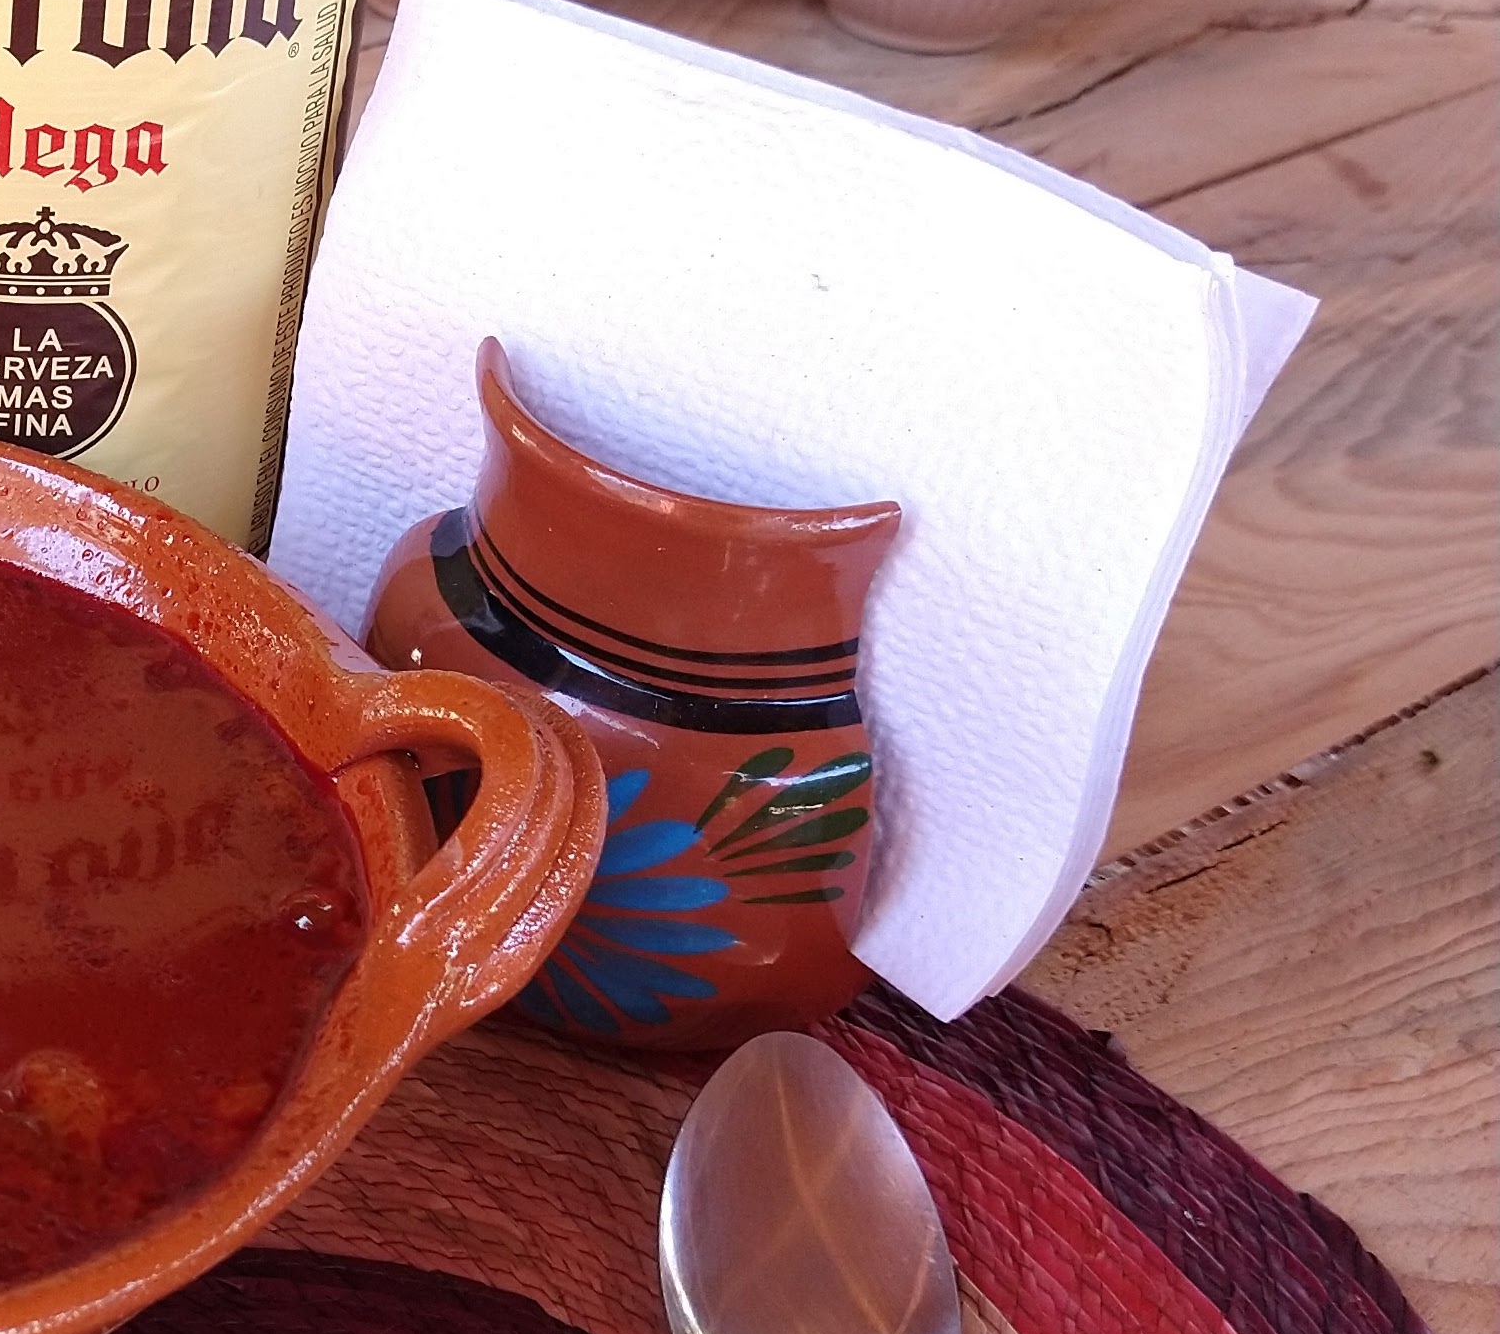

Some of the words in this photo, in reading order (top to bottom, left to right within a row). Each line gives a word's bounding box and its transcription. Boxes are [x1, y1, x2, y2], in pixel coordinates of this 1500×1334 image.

[312, 2, 338, 61] SALUD
[308, 58, 331, 87] LA
[302, 83, 328, 134] PARA
[294, 131, 322, 198] NOCIVO
[291, 194, 313, 221] ES
[279, 218, 310, 306] PRODUCTO
[12, 327, 63, 352] LA
[274, 302, 299, 347] ESTE
[272, 342, 293, 368] DE
[261, 365, 290, 443] CONSUMO
[256, 459, 278, 485] EN
[259, 438, 280, 464] EL
[250, 482, 274, 532] ABUSO
